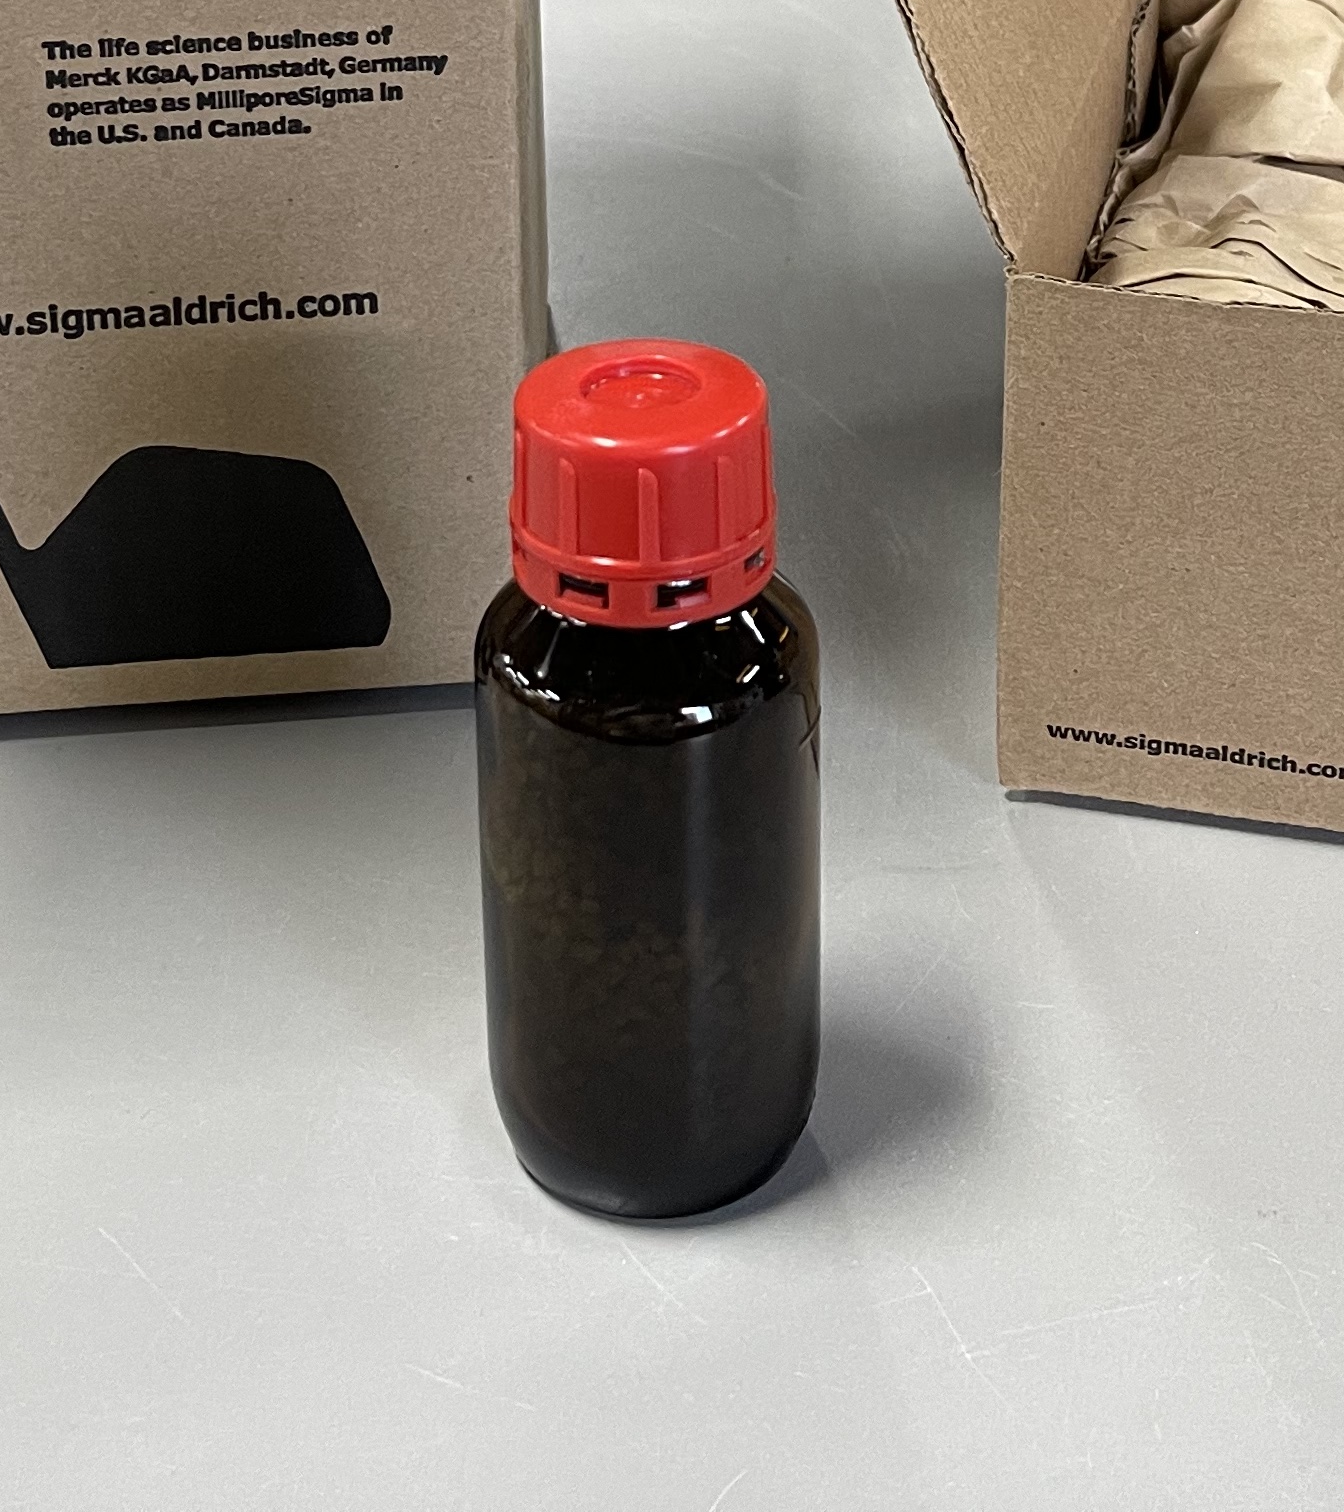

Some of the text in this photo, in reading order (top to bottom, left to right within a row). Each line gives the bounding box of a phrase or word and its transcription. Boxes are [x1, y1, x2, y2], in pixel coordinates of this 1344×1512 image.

[41, 24, 394, 61] The life science business of
[45, 54, 449, 89] Merck KGaA, Darmstadt, Germany
[46, 81, 404, 122] operates as MilliporeSigma in
[48, 115, 312, 147] the U.S. and Canada.
